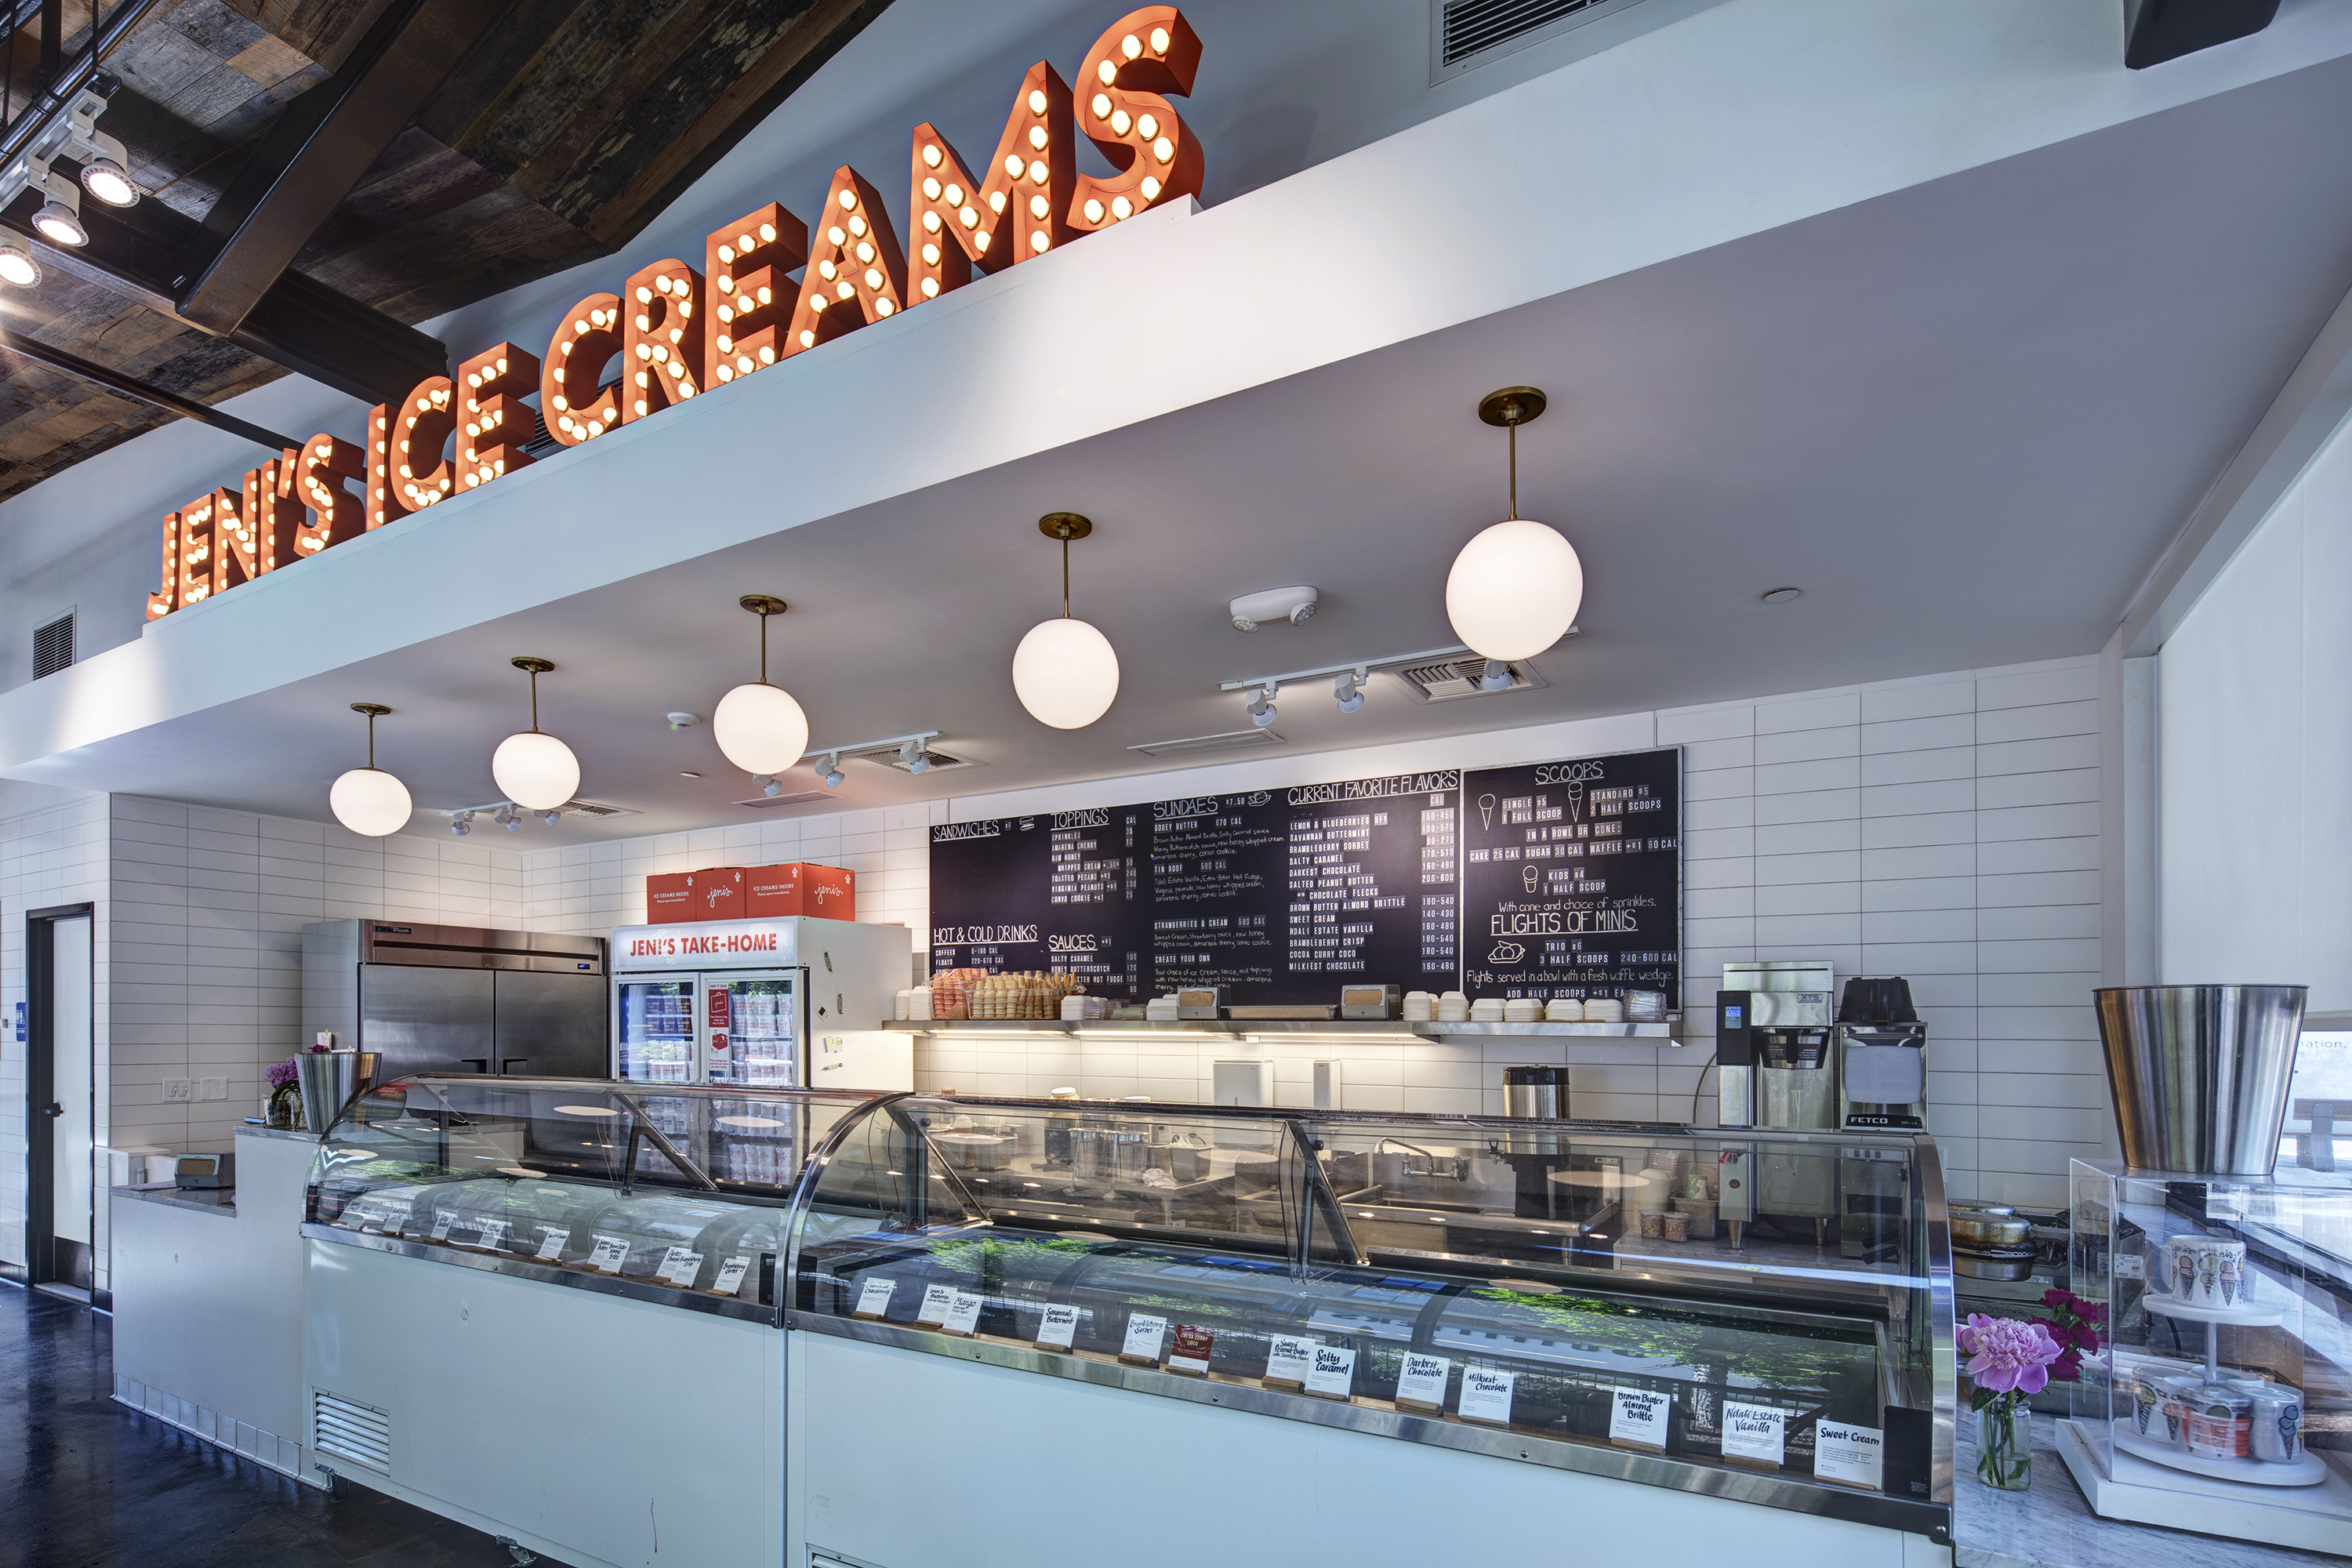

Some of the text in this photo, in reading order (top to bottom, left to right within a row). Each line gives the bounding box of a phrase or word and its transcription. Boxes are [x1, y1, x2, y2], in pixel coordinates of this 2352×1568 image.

[145, 5, 1204, 621] JENI'S ICE CREAMS
[1536, 761, 1603, 783] SCOOPS
[1287, 771, 1457, 804] CURRENT FAVORITE FLAVORS
[1591, 789, 1633, 800] STANDARD
[1430, 795, 1443, 804] CAL
[1503, 800, 1531, 809] SINGLE
[1601, 804, 1622, 813] HALF
[1628, 800, 1661, 810] SCOOPS
[1153, 797, 1218, 818] SUNDAES
[1051, 808, 1109, 828] TOPPINGS
[1323, 817, 1369, 828] BLUEBERRIES
[1422, 811, 1454, 821] 150-450
[1503, 810, 1561, 822] 1 FULL SCOOP
[934, 819, 999, 840] SANDWICHES
[1290, 823, 1454, 841] SAVANNAH BUTTERMINT 190-570
[1527, 824, 1621, 840] IN A BOWL OR CONE:
[1290, 837, 1454, 853] BRAMBLEBERRY SORBET 90-270
[1470, 851, 1489, 861] CAKE
[1505, 850, 1519, 858] CAL
[1526, 848, 1550, 858] SUGAR
[1569, 846, 1583, 855] CAL
[1590, 843, 1621, 853] WAFFLE
[1649, 840, 1658, 849] 80
[1661, 839, 1676, 848] CAL
[1290, 849, 1454, 865] SALTY CARAMEL 170-510
[1290, 861, 1454, 877] DARKEST CHOCOLATE 160-480
[1549, 871, 1568, 880] KIDS
[1290, 873, 1454, 888] SALTED PEANUT BUTTER 200-600
[1554, 884, 1573, 893] HALF
[1580, 882, 1606, 891] SCOOP
[1309, 888, 1378, 899] CHOCOLATE FLECKS
[1343, 901, 1368, 909] ALMOND
[1374, 898, 1405, 907] BRITTLE
[1422, 897, 1454, 906] 180-540
[1499, 895, 1656, 913] With cone and choice of sprinkles.
[1314, 926, 1338, 935] ESTATE
[1344, 924, 1373, 933] VANILLA
[1422, 922, 1454, 931] 160-480
[1491, 909, 1637, 934] FLIGHTS OF MINIS
[934, 924, 1037, 942] HOT & COLD DRINKS
[630, 933, 776, 956] JENI'S TAKE-HOME
[1048, 935, 1095, 949] SAUCES
[1290, 938, 1339, 947] BRAMBLEBERRY
[1422, 935, 1454, 943] 180-540
[1290, 950, 1310, 959] COCOA
[1422, 947, 1454, 956] 180-540
[1551, 955, 1570, 964] HALF
[1577, 954, 1608, 963] SCOOPS
[1621, 953, 1658, 962] 240-600
[1467, 971, 1493, 989] Flights
[1497, 971, 1526, 982] served
[1563, 968, 1577, 982] with
[1581, 972, 1586, 981] a
[1588, 968, 1607, 982] fresh
[1610, 968, 1635, 981] waffle
[1639, 968, 1673, 987] wedge.
[1507, 989, 1521, 998] ADD
[1555, 989, 1585, 997] SCOOPS
[1046, 1308, 1072, 1316] Savannah
[1316, 1349, 1340, 1365] Salty
[1407, 1357, 1439, 1369] Darkest
[1316, 1362, 1349, 1375] Caramel
[1408, 1367, 1443, 1377] Chocolate
[1465, 1374, 1497, 1384] Milkiest
[1475, 1382, 1508, 1392] Chocolate
[1618, 1392, 1665, 1406] Brown Butter
[1622, 1401, 1651, 1412] Almond
[1628, 1410, 1653, 1421] Brittle
[1726, 1408, 1782, 1423] Ndali Estate
[1735, 1420, 1770, 1433] Vanilla
[1820, 1428, 1879, 1445] Sweet Cream
